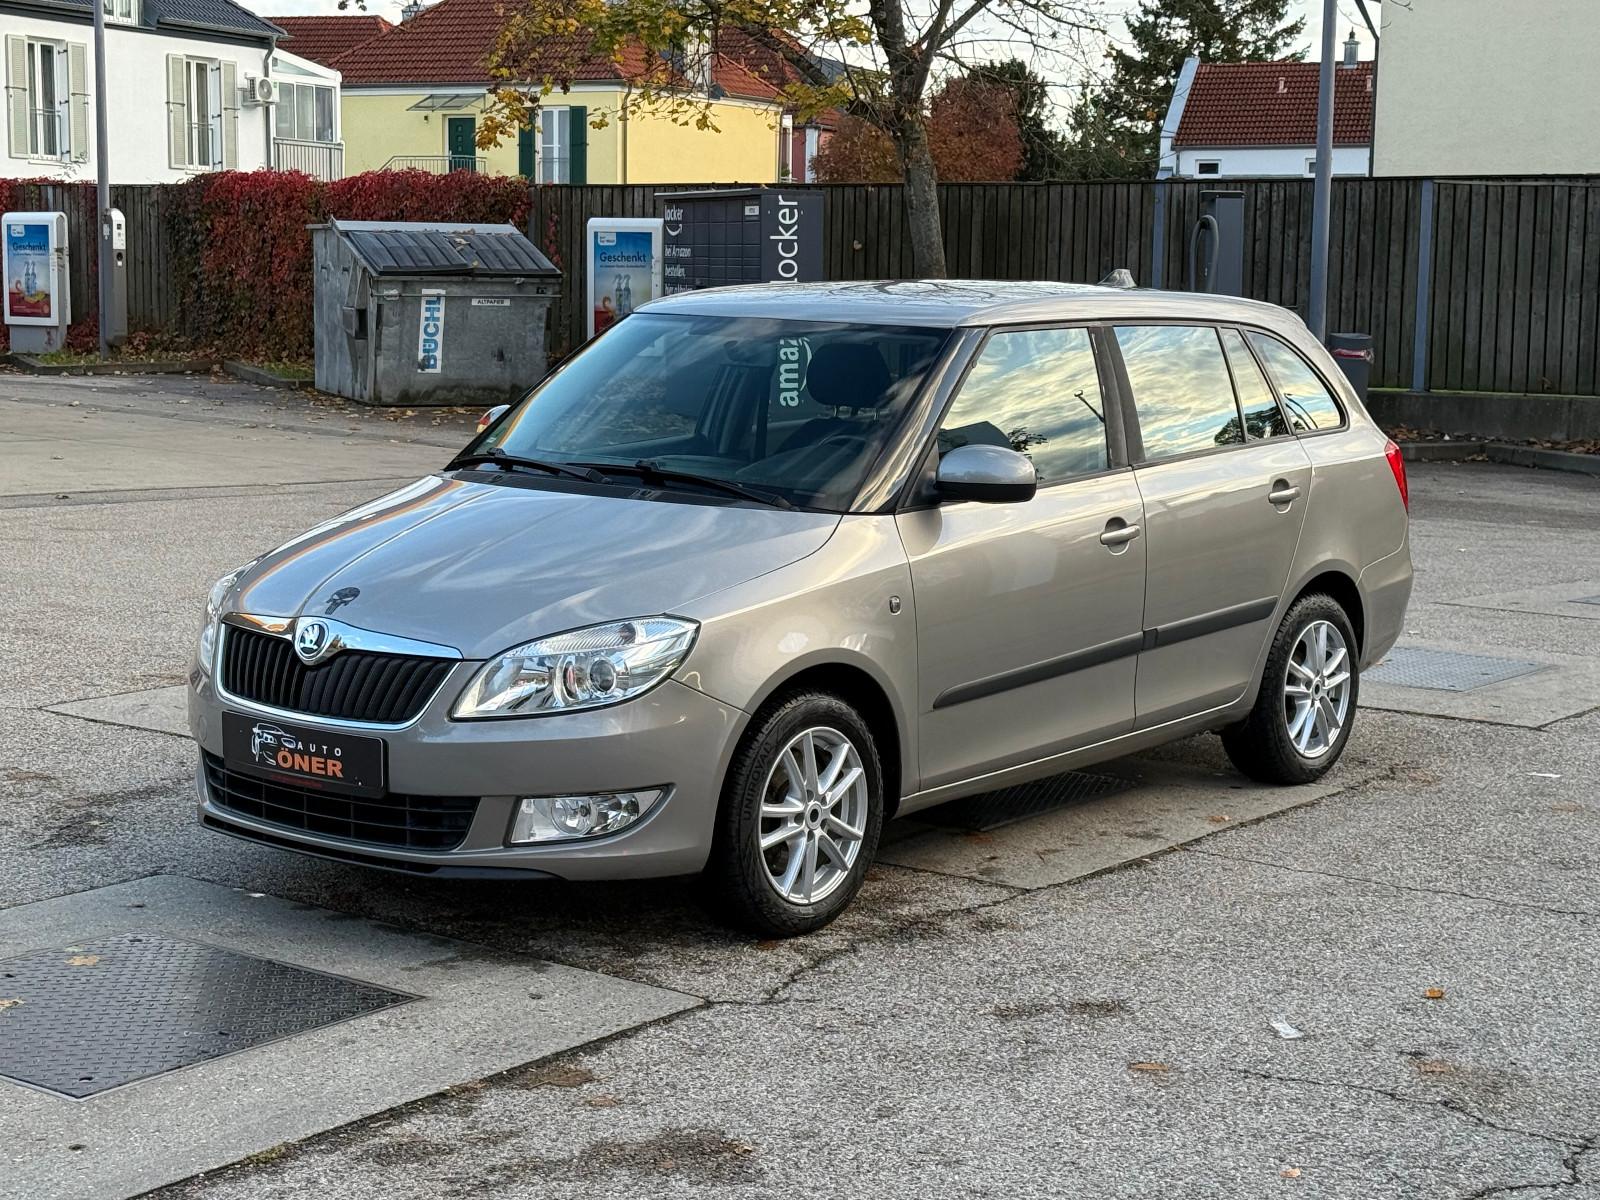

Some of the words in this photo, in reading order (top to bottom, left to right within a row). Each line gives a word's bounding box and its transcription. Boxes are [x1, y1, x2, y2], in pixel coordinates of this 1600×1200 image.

[664, 204, 684, 221] locker
[12, 241, 46, 252] Geschenkt
[769, 194, 799, 284] locker
[600, 251, 647, 263] Geschenkt
[664, 245, 672, 257] bei
[672, 245, 691, 258] Amazon
[297, 741, 342, 757] AUTO
[277, 747, 344, 778] ÖNER
[743, 741, 772, 820] UNIROYAL
